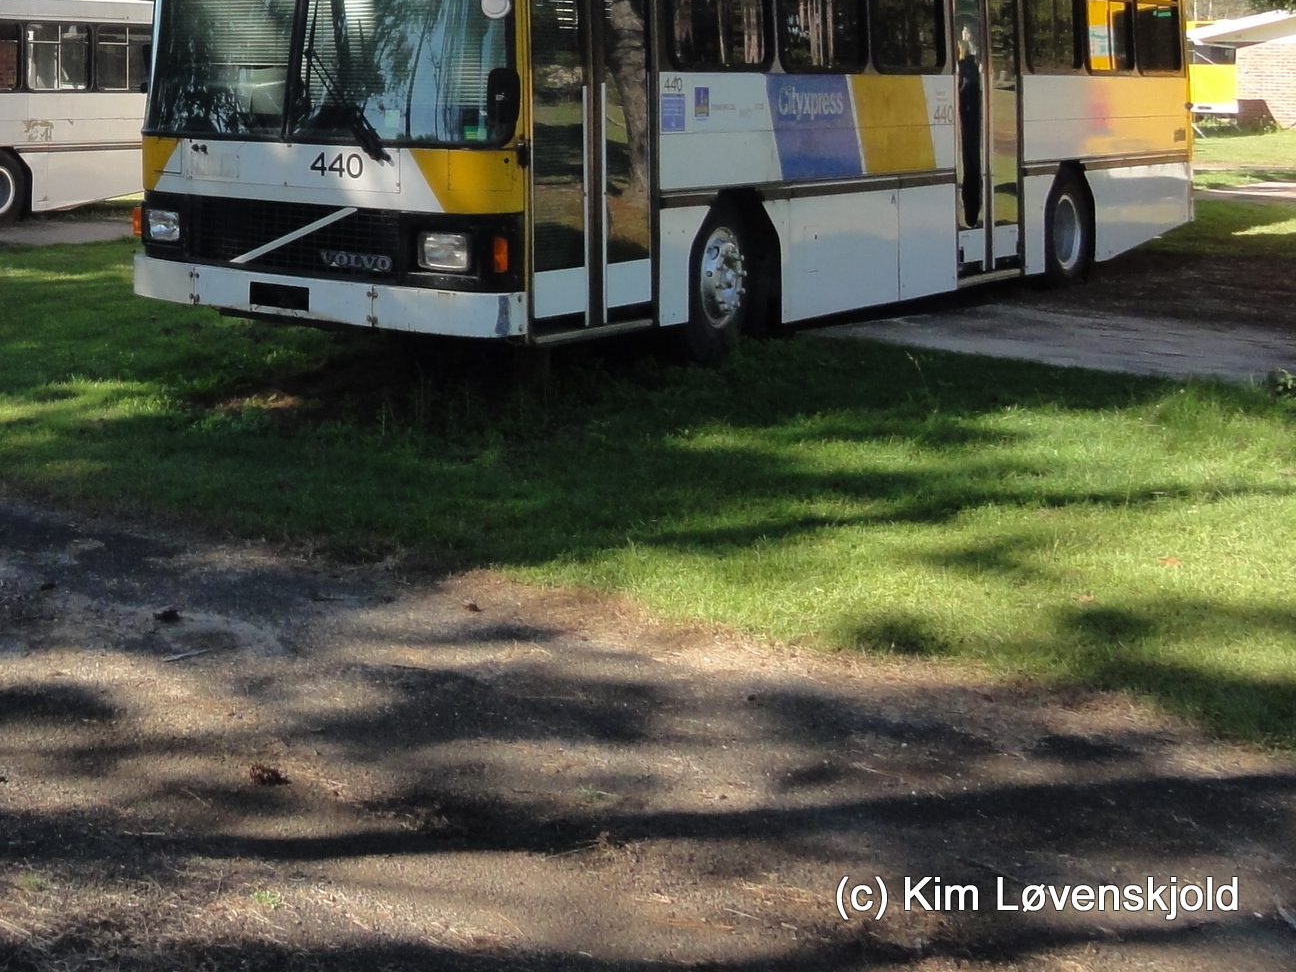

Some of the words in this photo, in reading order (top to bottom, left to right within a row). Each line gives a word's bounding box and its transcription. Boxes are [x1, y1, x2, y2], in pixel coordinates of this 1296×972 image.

[664, 76, 683, 93] 440
[933, 104, 954, 125] 440
[310, 151, 363, 179] 440
[320, 251, 393, 273] VOLVO
